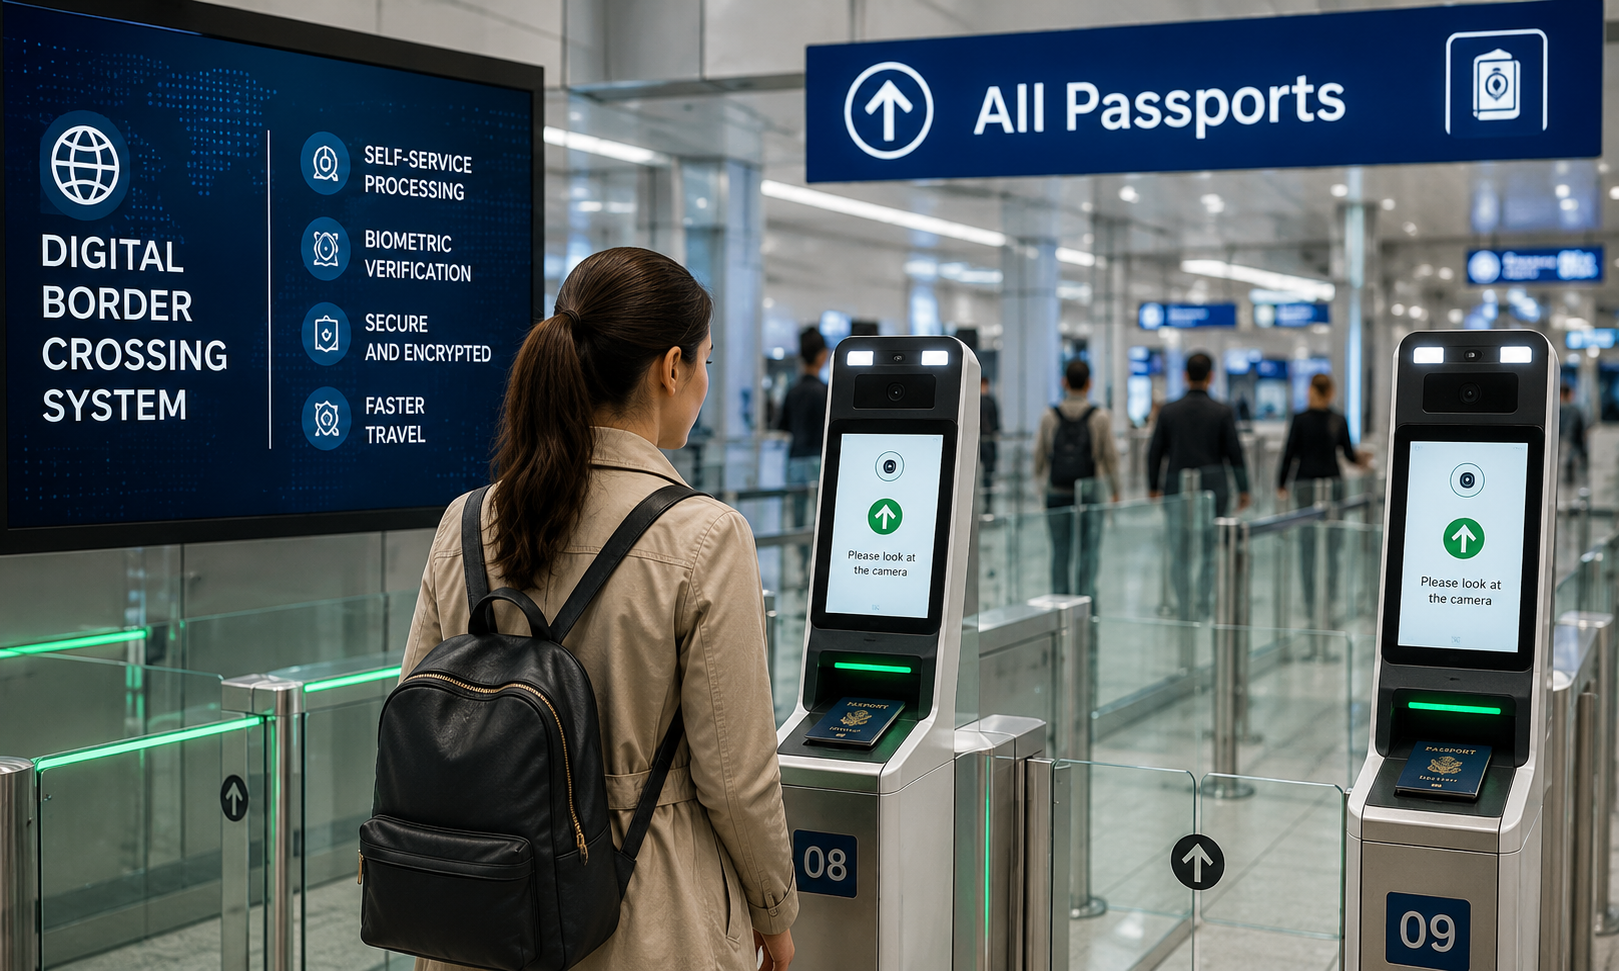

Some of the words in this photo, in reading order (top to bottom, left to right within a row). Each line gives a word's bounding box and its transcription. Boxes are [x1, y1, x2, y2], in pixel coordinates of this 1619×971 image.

[974, 82, 1044, 135] All
[1066, 75, 1346, 140] Passports
[364, 144, 473, 174] SELF-SERVICE
[364, 174, 465, 201] PROCESSING
[41, 233, 184, 273] DIGITAL
[365, 229, 452, 253] BIOMETRIC
[364, 259, 472, 282] VERIFICATION
[42, 285, 193, 322] BORDER
[364, 313, 429, 333] SECURE
[42, 336, 227, 372] CROSSING
[364, 342, 400, 362] AND
[404, 343, 492, 363] ENCRYPTED
[42, 388, 186, 422] SYSTEM
[365, 396, 425, 415] FASTER
[365, 425, 426, 444] TRAVEL
[847, 549, 880, 561] Please
[882, 551, 904, 562] look
[906, 554, 916, 562] at
[853, 565, 870, 576] the
[872, 567, 908, 577] camera
[1420, 575, 1459, 589] Please
[1462, 578, 1487, 590] look
[1489, 580, 1502, 591] at
[1428, 593, 1448, 604] the
[1450, 595, 1492, 606] camera
[803, 845, 847, 882] 08
[1398, 909, 1457, 955] 09
